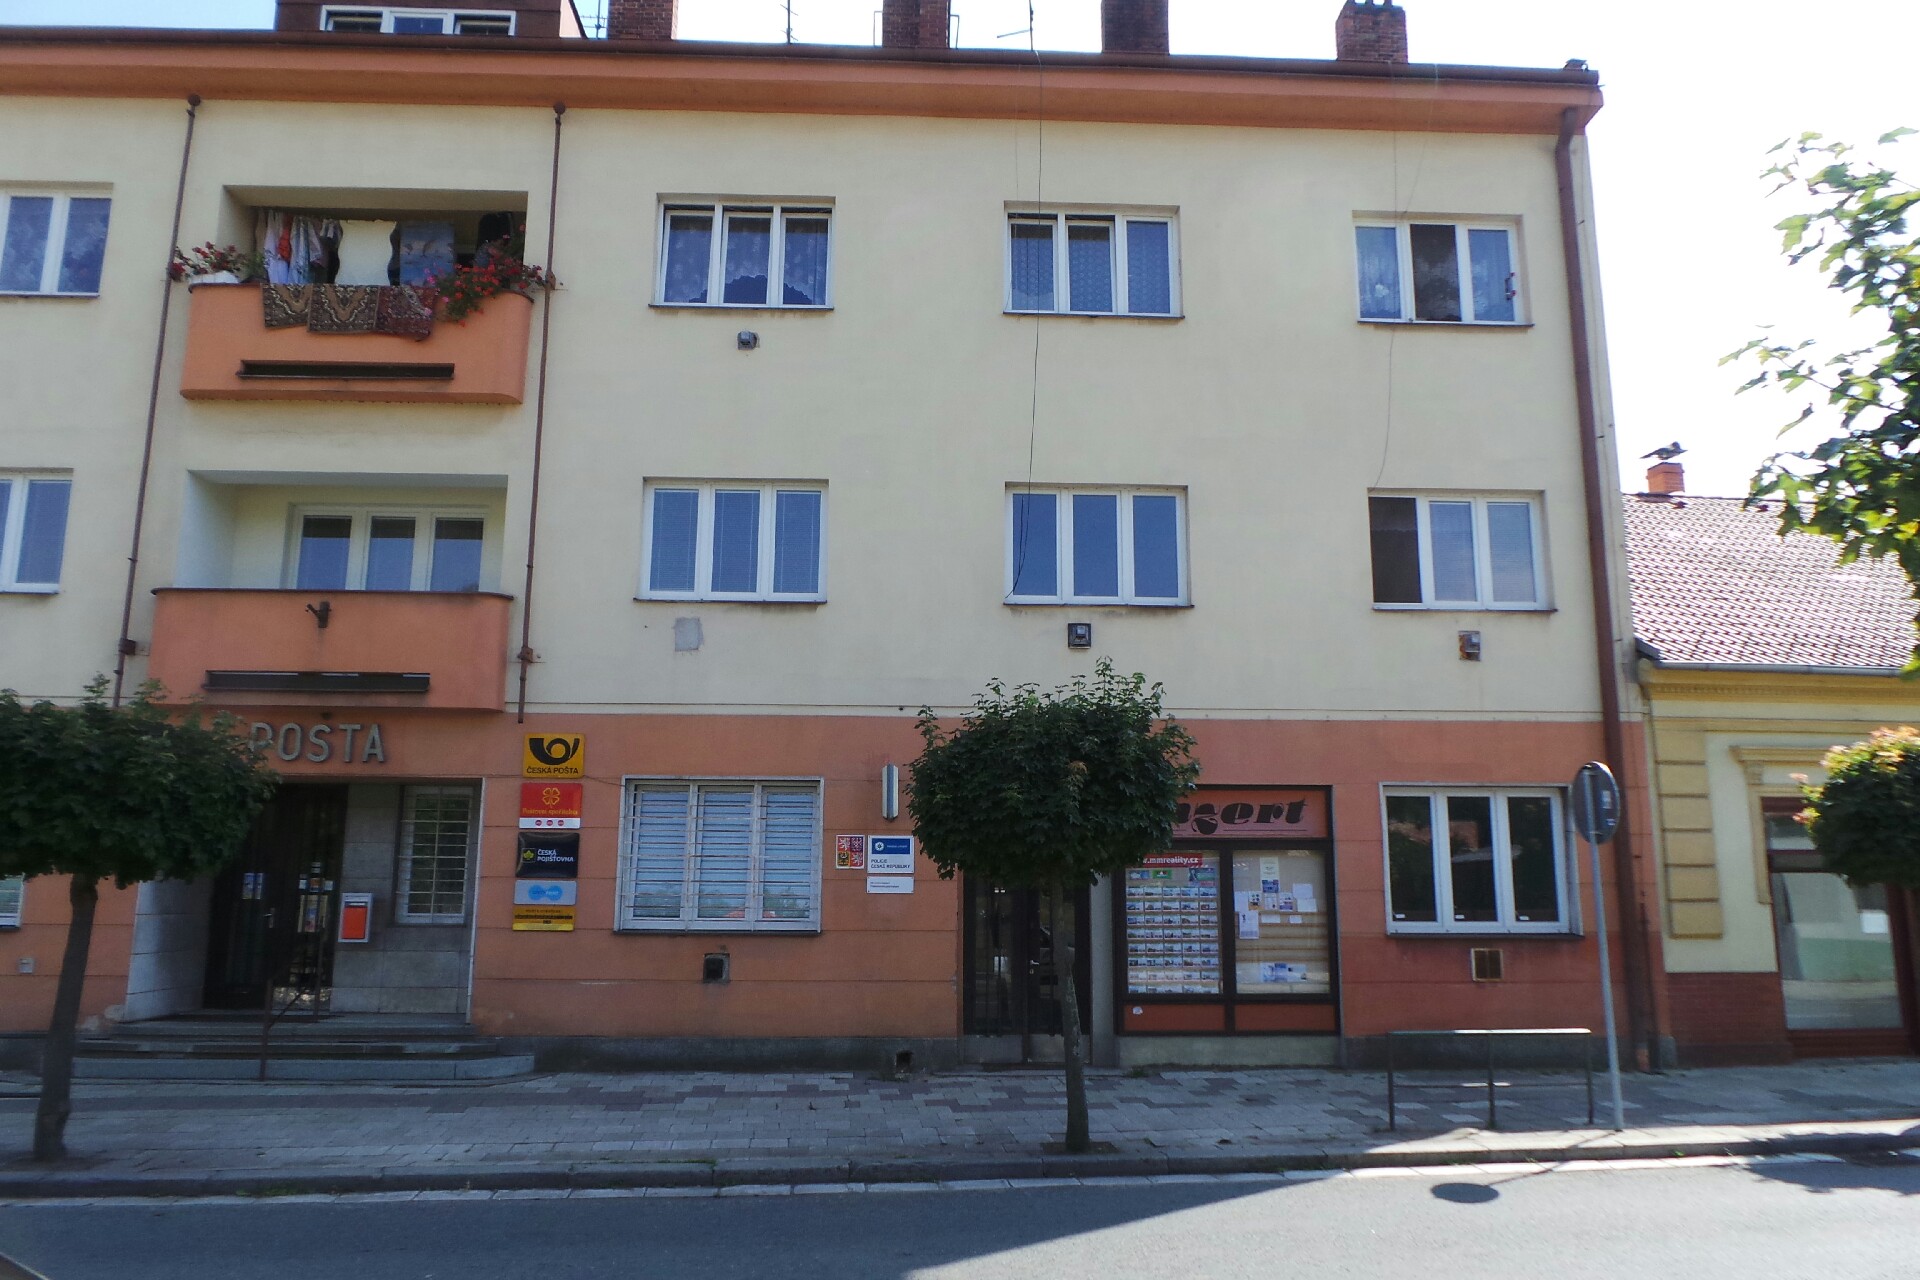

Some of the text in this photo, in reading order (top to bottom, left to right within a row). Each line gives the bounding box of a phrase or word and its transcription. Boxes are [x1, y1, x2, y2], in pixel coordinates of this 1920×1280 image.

[526, 765, 579, 775] ČESKÁ POŠTA
[537, 848, 557, 856] ČESKÁ
